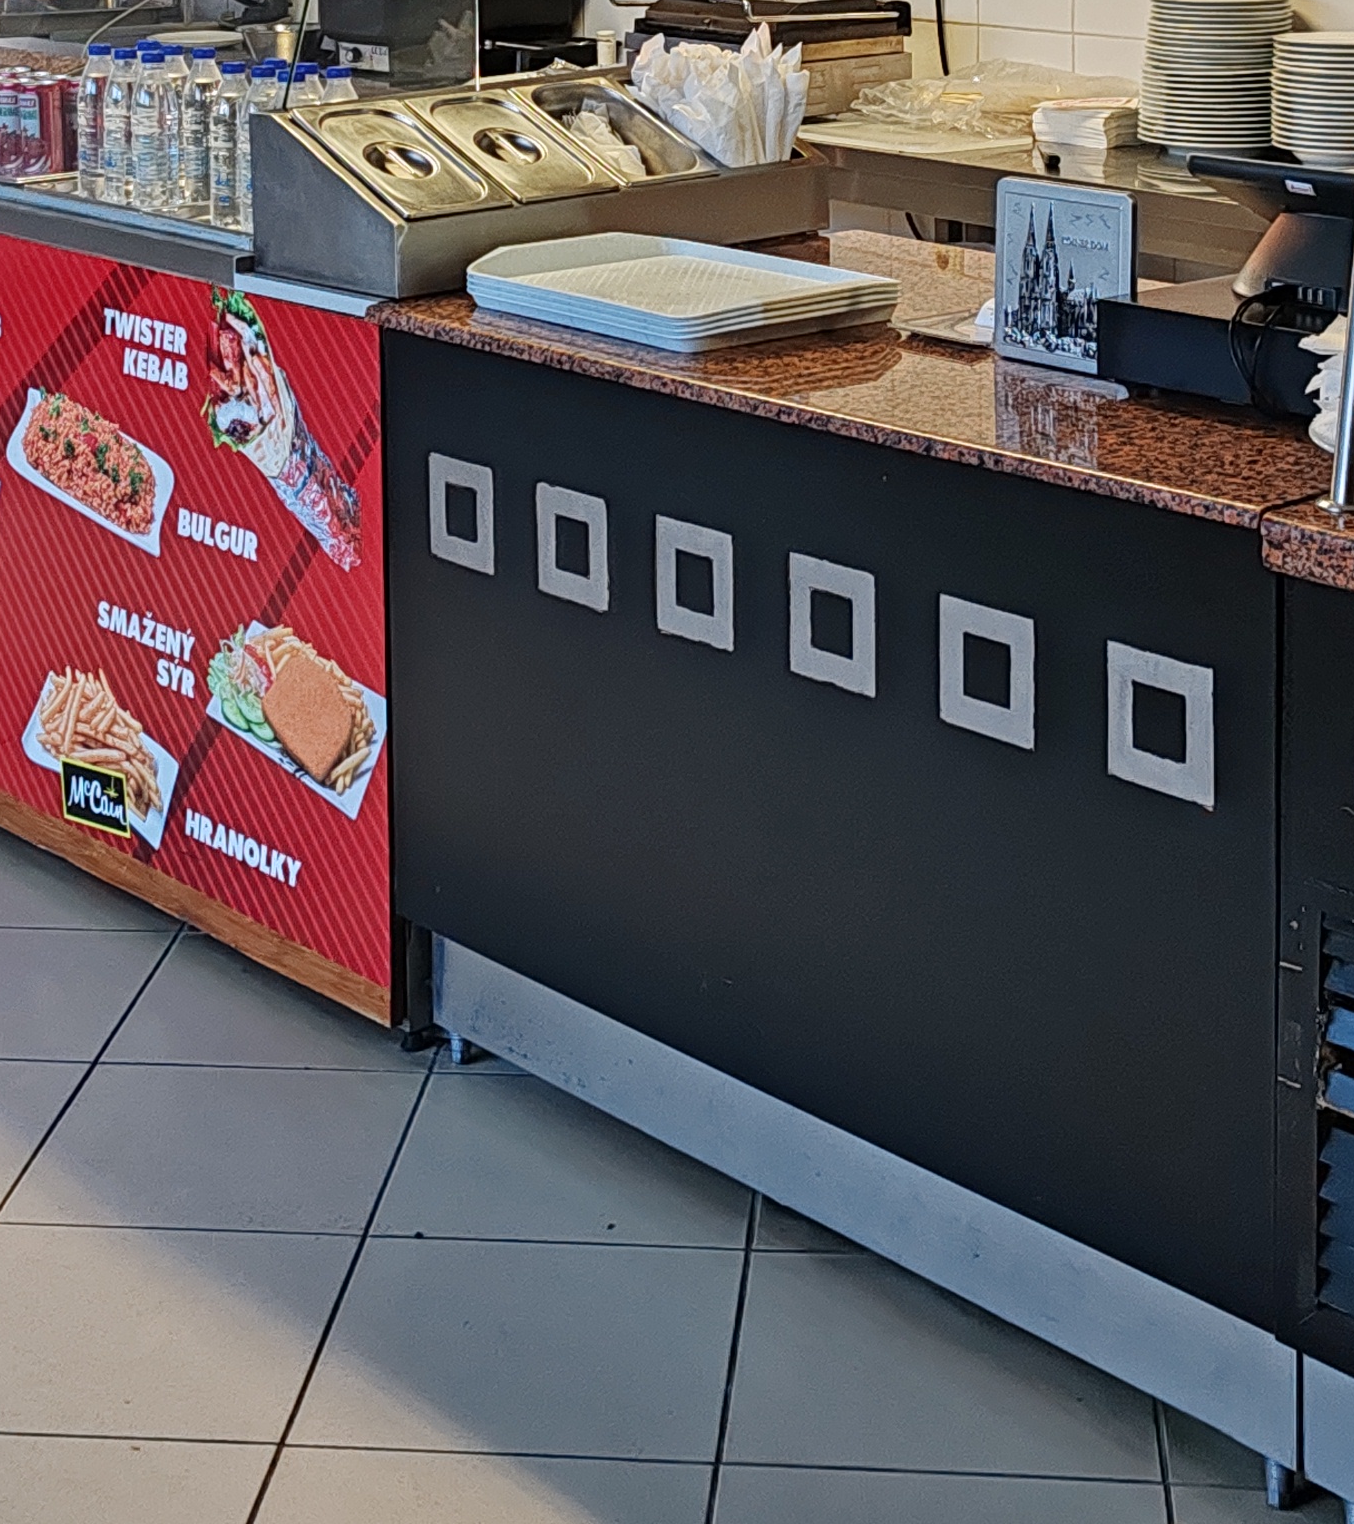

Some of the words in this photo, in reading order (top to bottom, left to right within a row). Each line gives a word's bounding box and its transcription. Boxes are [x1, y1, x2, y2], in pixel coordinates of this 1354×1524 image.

[103, 307, 188, 356] TWISTER
[123, 347, 189, 391] KEBAB
[177, 507, 258, 562] BULGUR
[97, 600, 196, 663] SMAŽENÝ
[156, 658, 195, 699] SÝR
[68, 775, 127, 826] McCain
[185, 808, 302, 888] HRANOLKY
